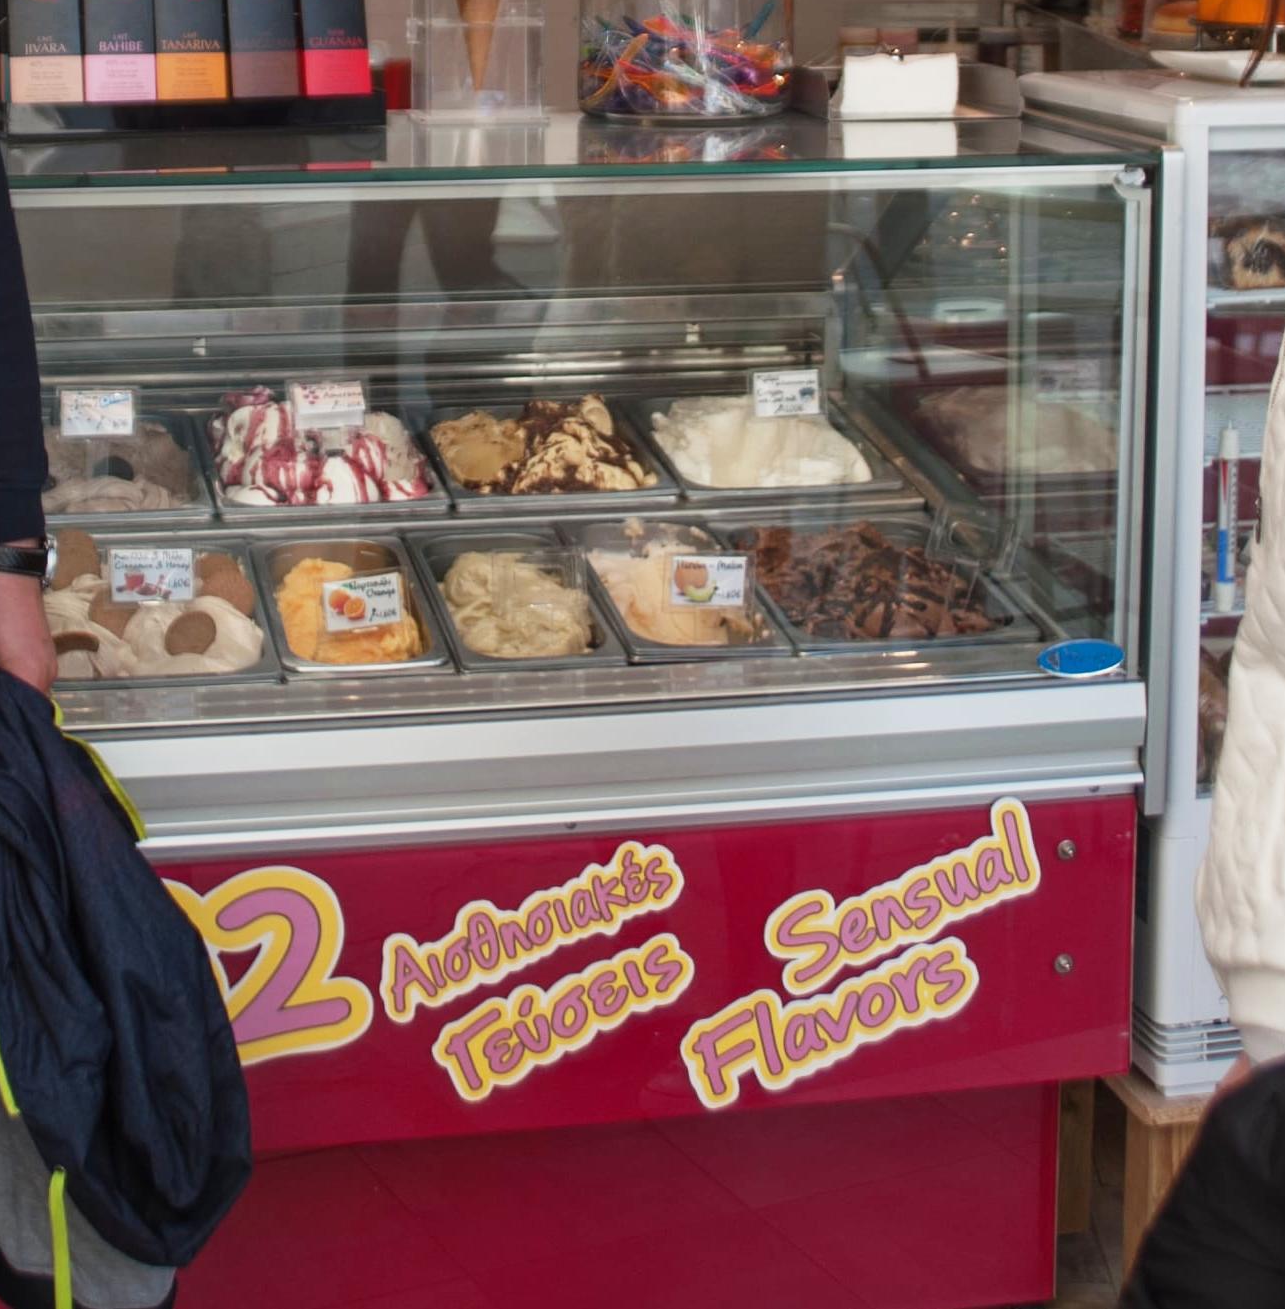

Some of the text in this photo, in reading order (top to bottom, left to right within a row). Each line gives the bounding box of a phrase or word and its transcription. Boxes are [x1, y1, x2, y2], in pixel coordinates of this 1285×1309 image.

[25, 43, 67, 55] JIVARA
[99, 40, 143, 52] BAHIBE
[162, 39, 221, 50] TANARIVA
[390, 848, 674, 1014] Αισθησιακές
[776, 810, 1031, 983] Sensual
[444, 943, 684, 1091] Γεύσεις
[692, 949, 966, 1096] Flavors
